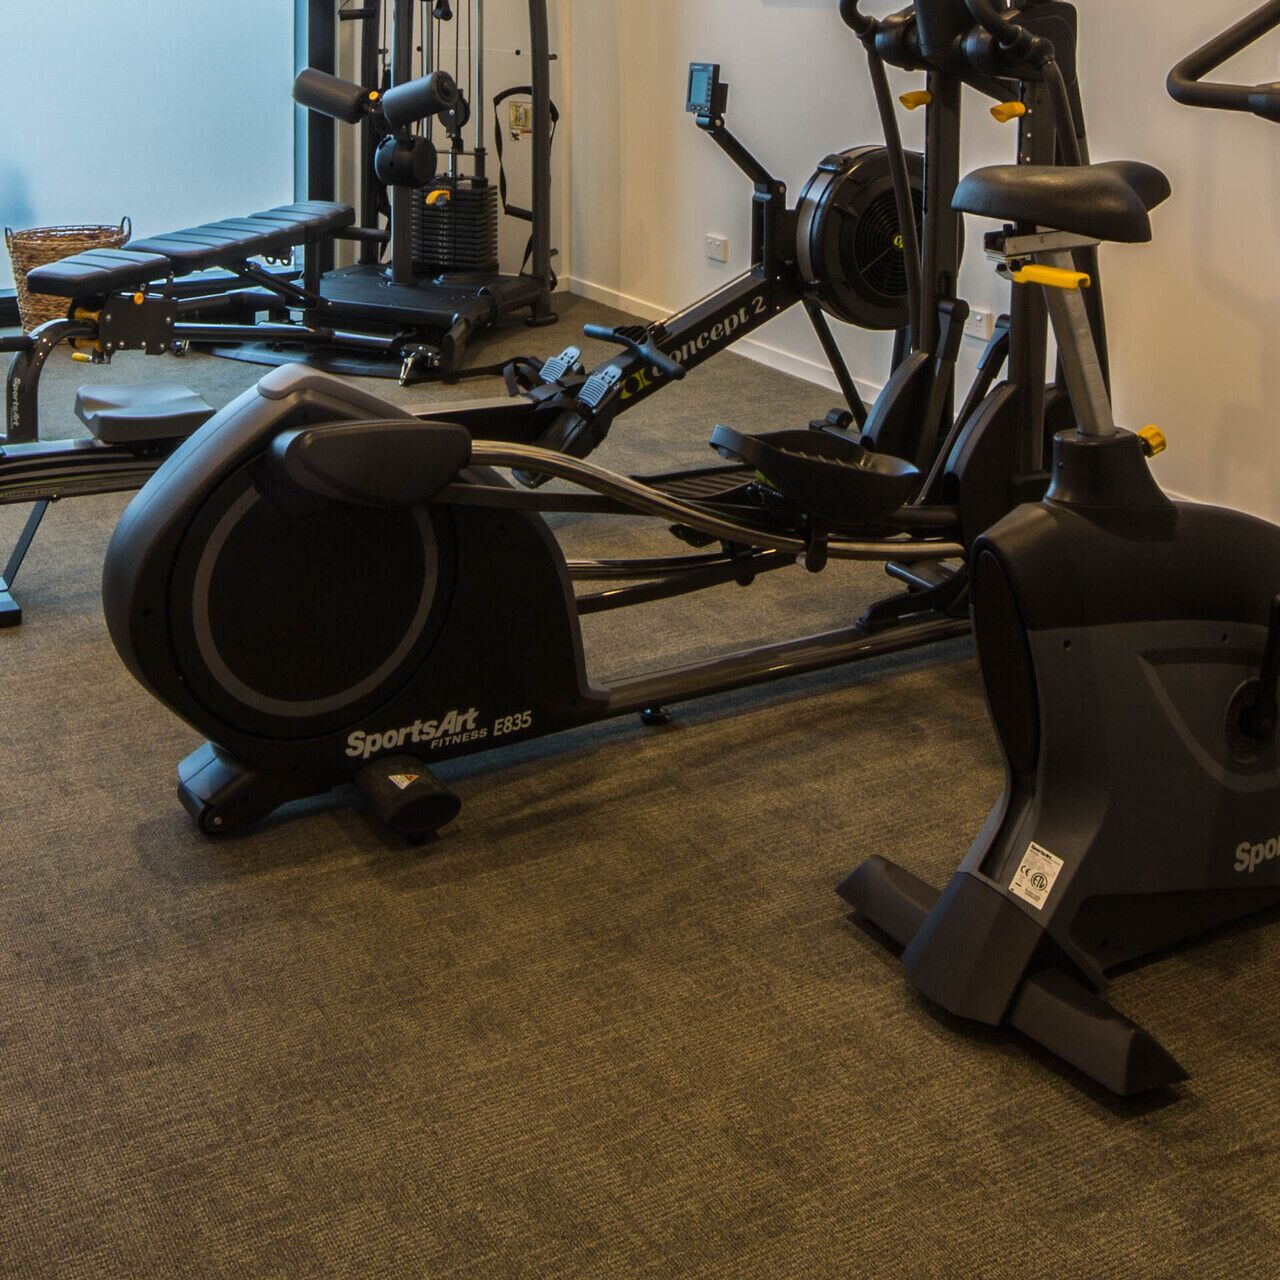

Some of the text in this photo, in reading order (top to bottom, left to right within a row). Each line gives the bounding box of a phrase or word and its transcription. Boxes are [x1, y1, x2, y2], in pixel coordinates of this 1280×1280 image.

[652, 295, 767, 377] oncept 2
[345, 707, 533, 759] SportsArt FITNESS E835
